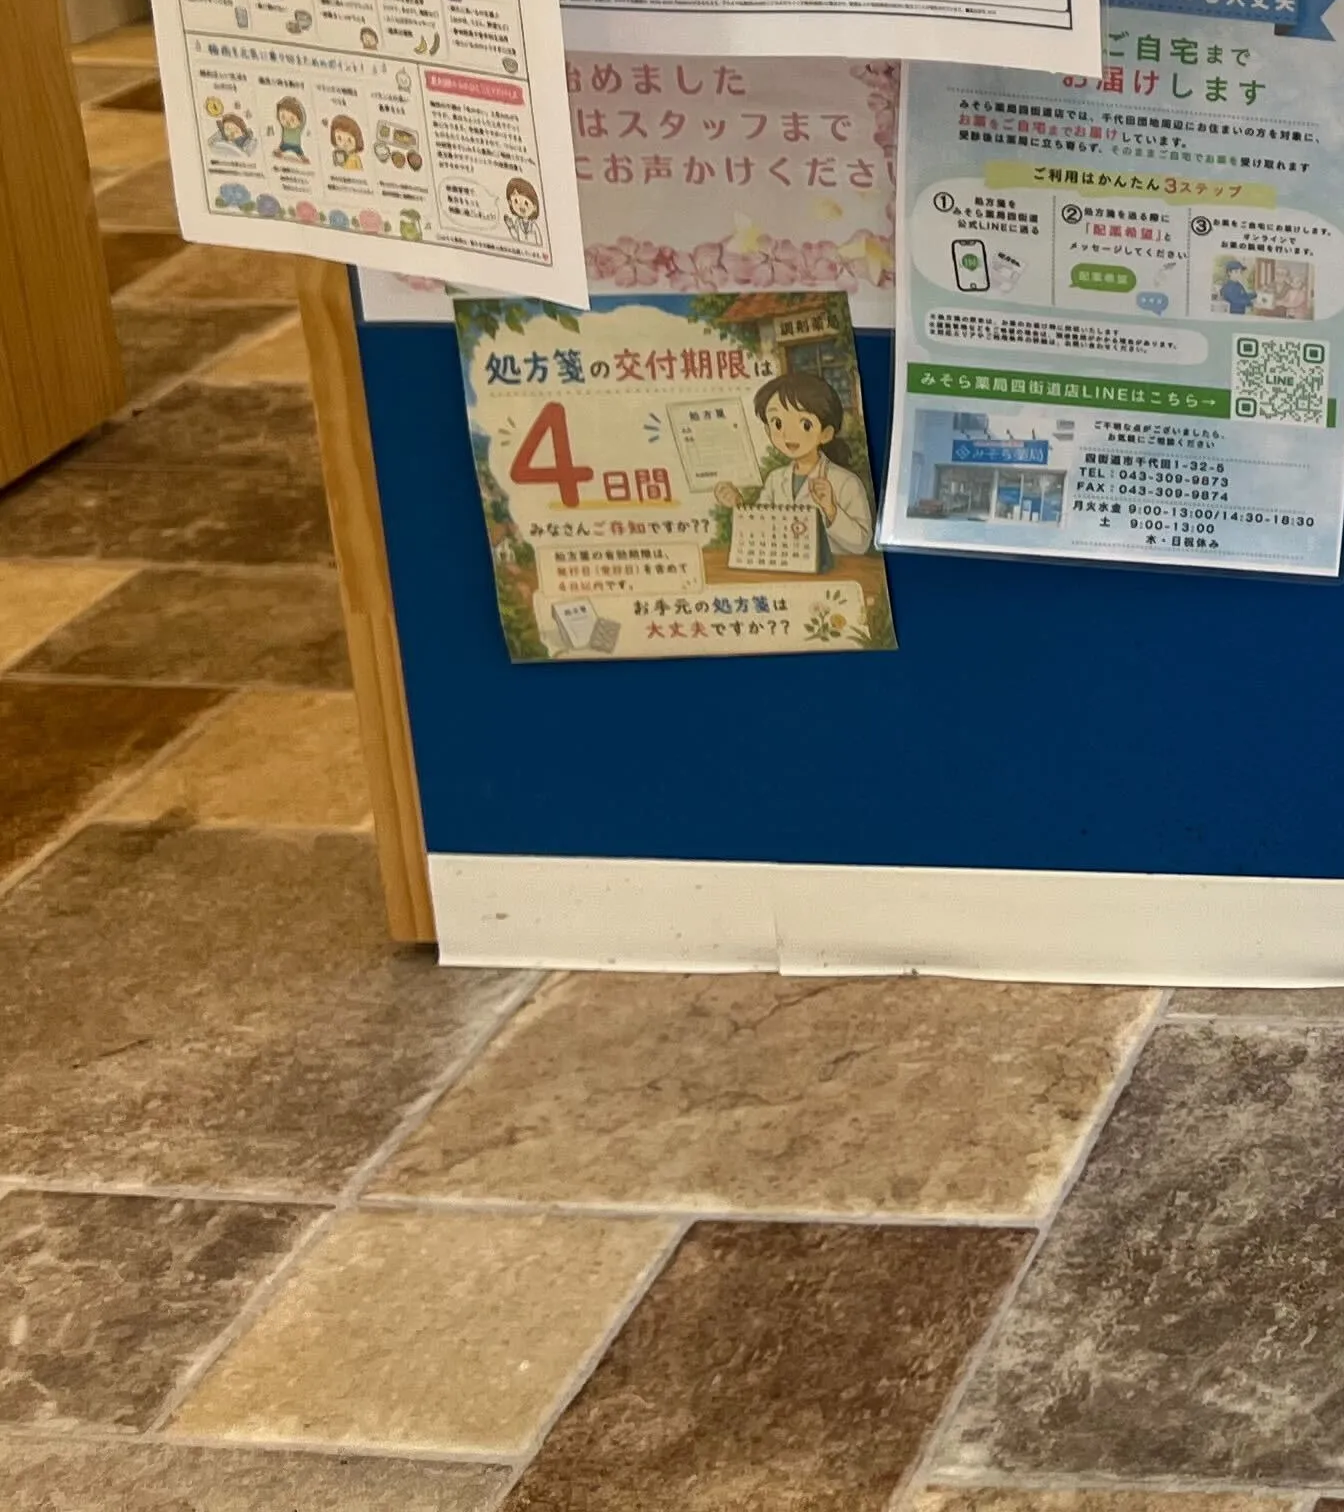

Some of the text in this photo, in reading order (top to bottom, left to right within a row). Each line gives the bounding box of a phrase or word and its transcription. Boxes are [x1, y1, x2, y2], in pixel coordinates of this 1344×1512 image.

[485, 348, 774, 384] 処方箋の交付期限は
[1265, 374, 1294, 387] LINE
[633, 595, 788, 614] お手元の処方箋は
[645, 619, 791, 639] 大丈夫ですか??
